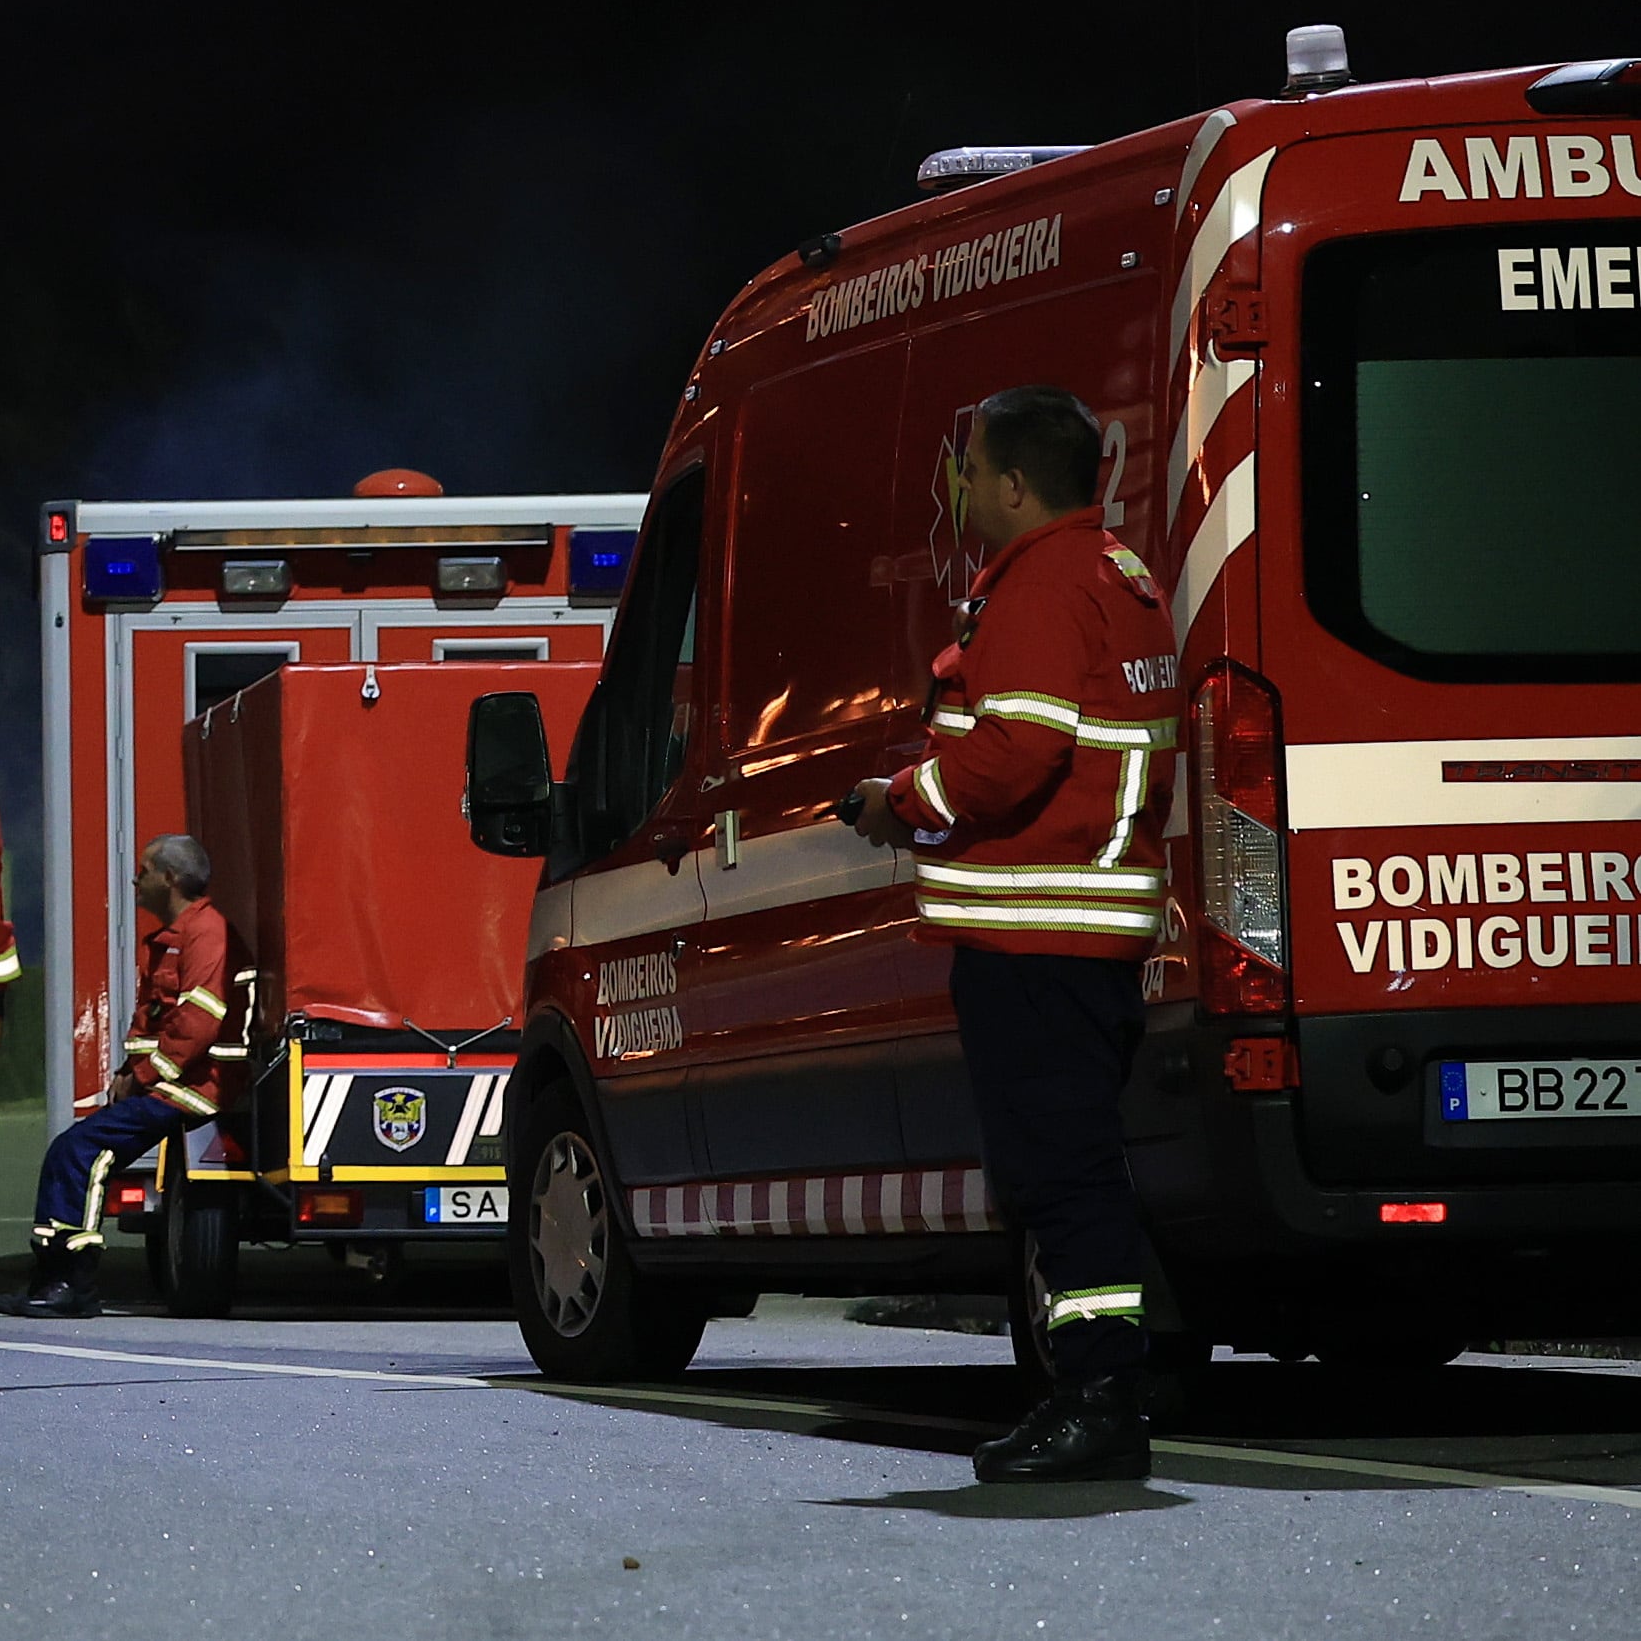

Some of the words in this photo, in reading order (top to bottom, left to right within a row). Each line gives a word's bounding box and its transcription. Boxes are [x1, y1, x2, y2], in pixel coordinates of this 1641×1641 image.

[806, 252, 928, 343] BOMBEIROS
[931, 213, 1062, 303] VIDIGUEIRA
[1498, 246, 1641, 311] EME
[1332, 852, 1641, 910] BOMBEIR
[1336, 915, 1641, 974] VIDIGUEI
[597, 951, 678, 1006] BOMBEIROS
[594, 1006, 683, 1058] VIDIGUEIRA
[1450, 1097, 1461, 1111] P
[1497, 1067, 1564, 1112] BB
[1573, 1065, 1628, 1111] 22
[451, 1190, 499, 1218] SA
